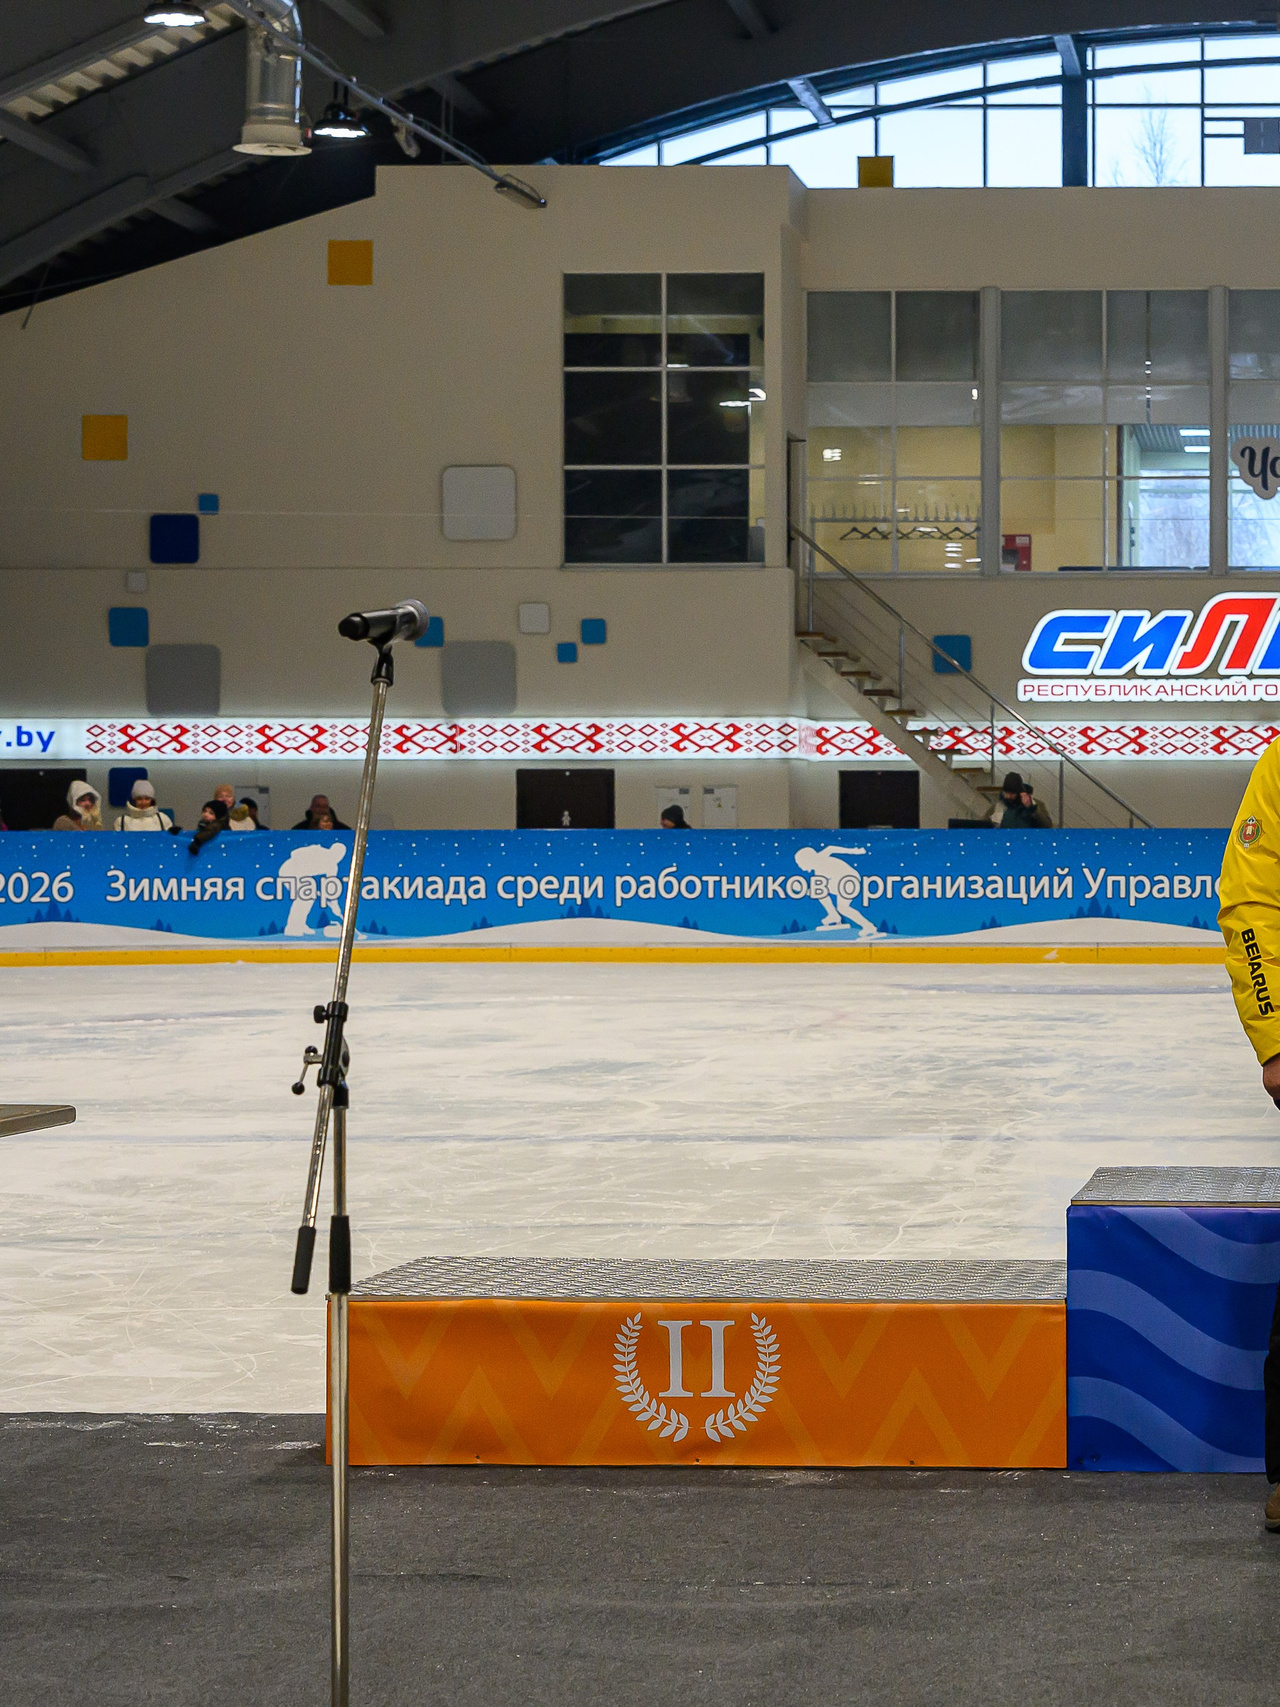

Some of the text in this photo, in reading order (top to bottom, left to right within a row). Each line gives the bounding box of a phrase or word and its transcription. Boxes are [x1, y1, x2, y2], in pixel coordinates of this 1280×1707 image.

[1022, 681, 1247, 697] РЕСПУБЛИКАНСКИЙ
[0, 725, 56, 753] .by
[0, 871, 75, 903] 026
[105, 870, 245, 902] Зимняя
[255, 875, 487, 909] спаракиада
[496, 875, 604, 907] среди
[614, 865, 829, 908] работников
[837, 867, 1074, 907] организаций
[1082, 867, 1221, 907] Управл
